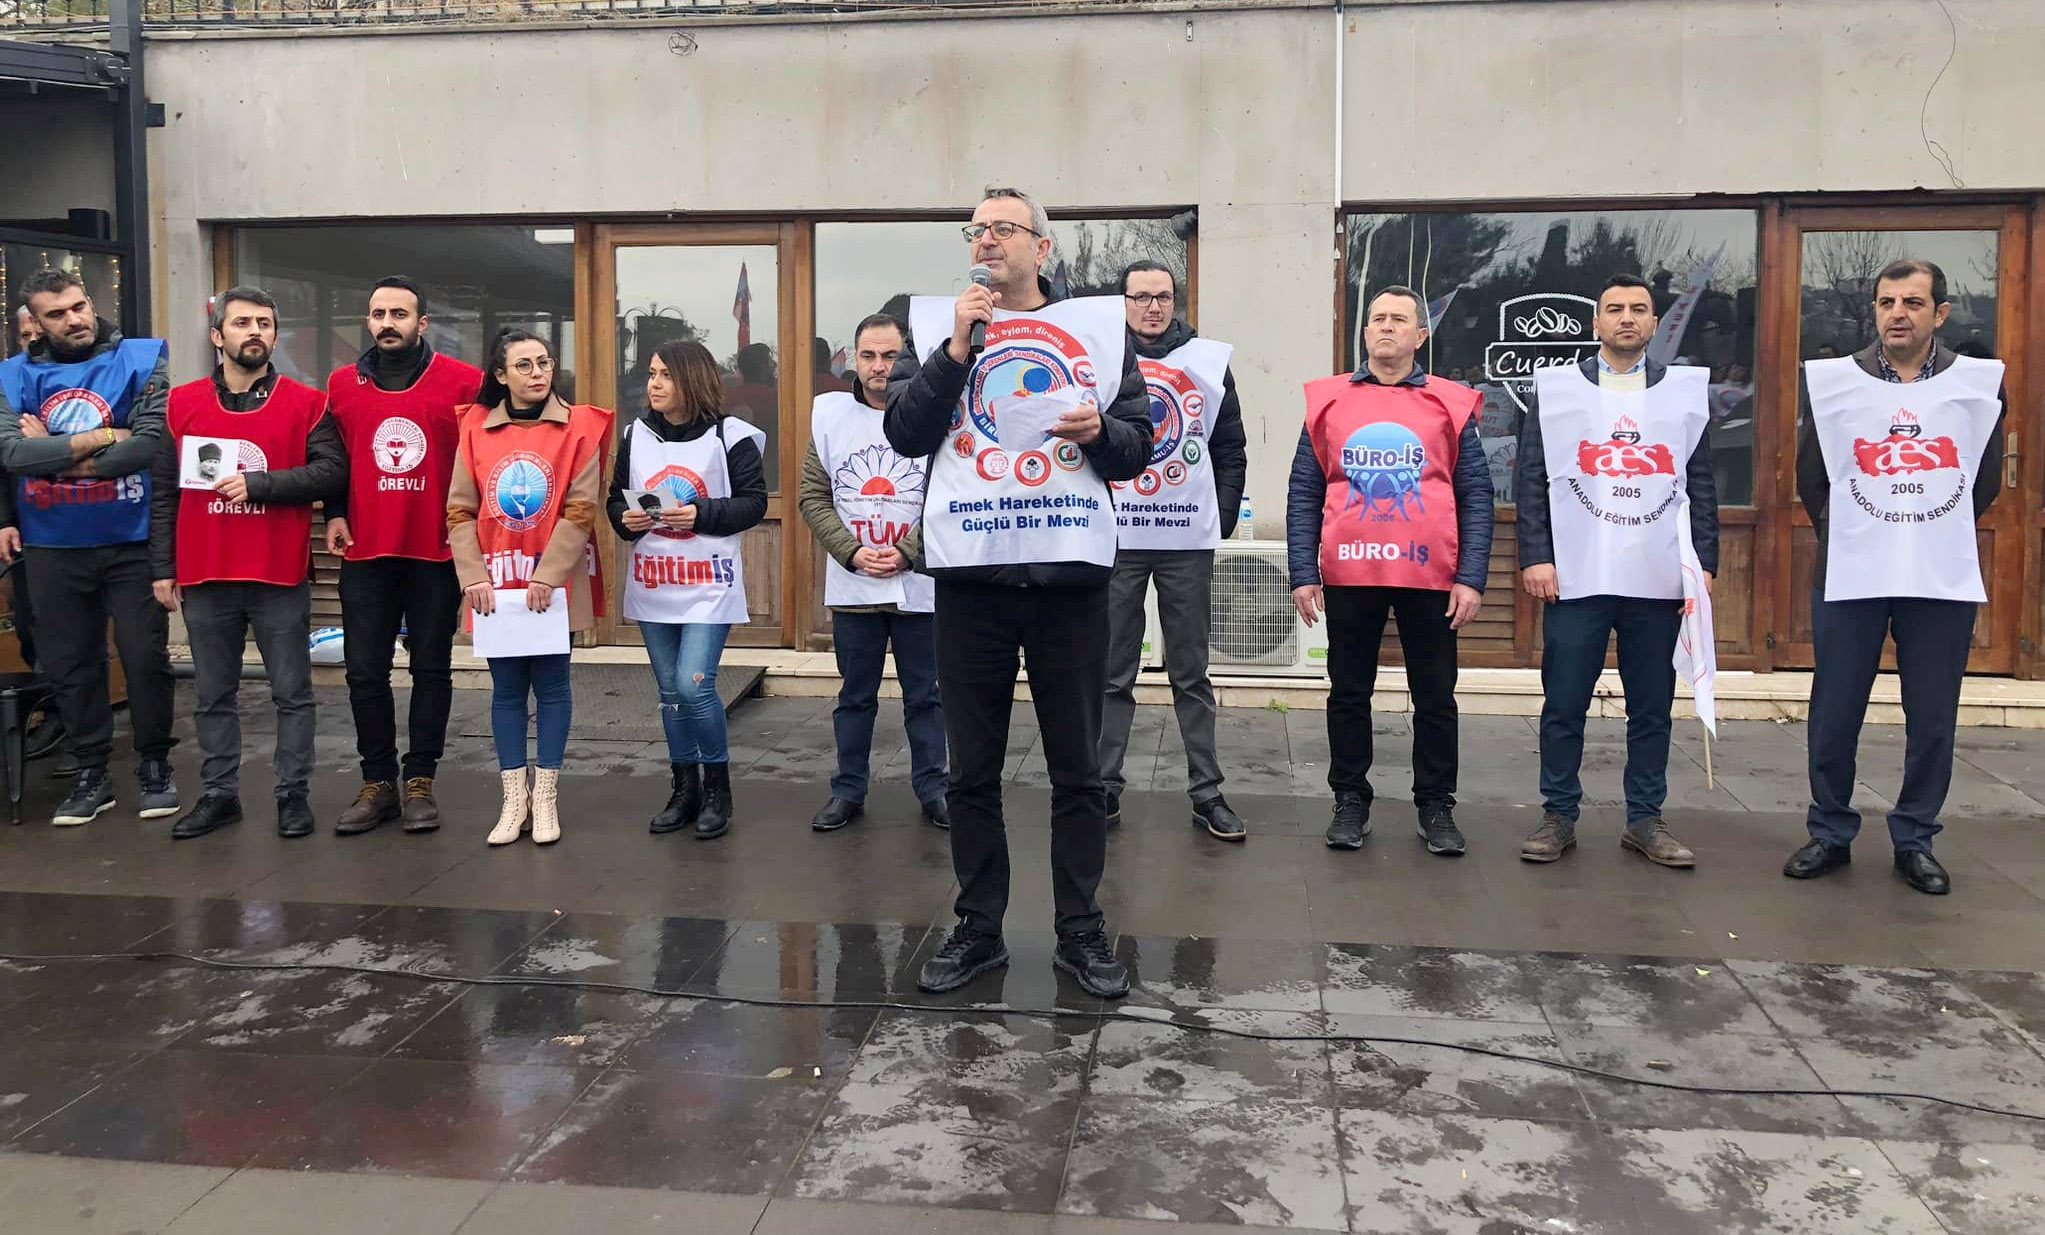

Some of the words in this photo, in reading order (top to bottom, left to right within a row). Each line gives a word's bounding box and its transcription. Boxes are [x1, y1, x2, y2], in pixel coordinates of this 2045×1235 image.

[1001, 327, 1033, 336] eylem,
[1496, 348, 1593, 375] Cuerd
[1342, 443, 1424, 469] BÜRO-İŞ
[1612, 485, 1641, 499] 2005
[1849, 478, 1883, 519] ANADOLU
[1884, 511, 1926, 523] EĞİTİM
[1927, 473, 1967, 521] SENDİKASI
[1891, 482, 1925, 495] 2005
[949, 499, 993, 513] Emek
[1000, 494, 1099, 510] Hareketinde
[1121, 502, 1199, 513] Hareketinde
[1568, 477, 1603, 518] ANADOLU
[1604, 511, 1642, 526] EĞİTİM
[850, 514, 910, 546] TÜM
[962, 516, 1010, 534] Güçlü
[1016, 515, 1041, 529] Bir
[1047, 514, 1089, 528] Mevzi
[1132, 516, 1151, 527] Bir
[1154, 516, 1190, 528] Mevzi
[1338, 539, 1429, 567] BÜRO-İŞ
